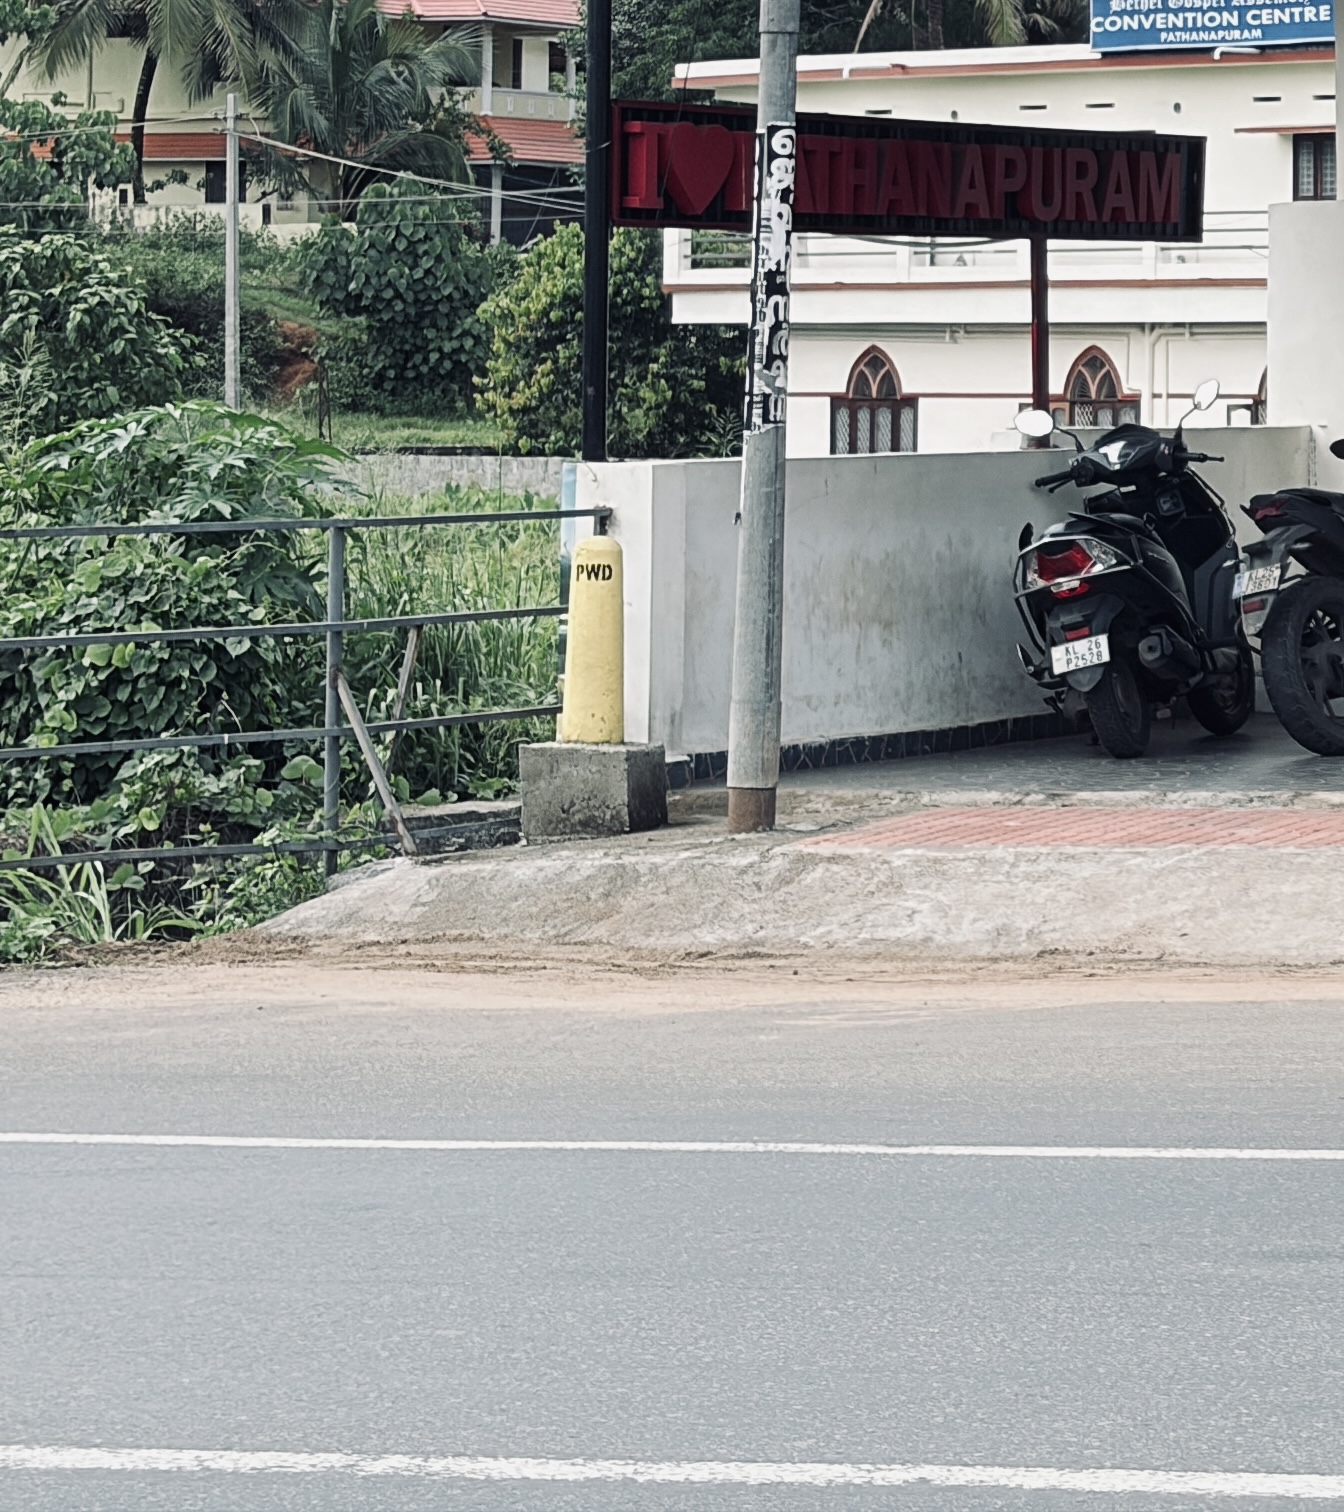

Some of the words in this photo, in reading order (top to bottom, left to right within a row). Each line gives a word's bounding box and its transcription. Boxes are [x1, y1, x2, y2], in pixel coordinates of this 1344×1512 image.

[1091, 10, 1239, 33] CONVENTION
[1246, 5, 1332, 25] CENTRE
[1160, 28, 1262, 43] PATHANAPURAM
[724, 129, 1181, 224] THANAPURAM
[576, 563, 613, 582] PWD
